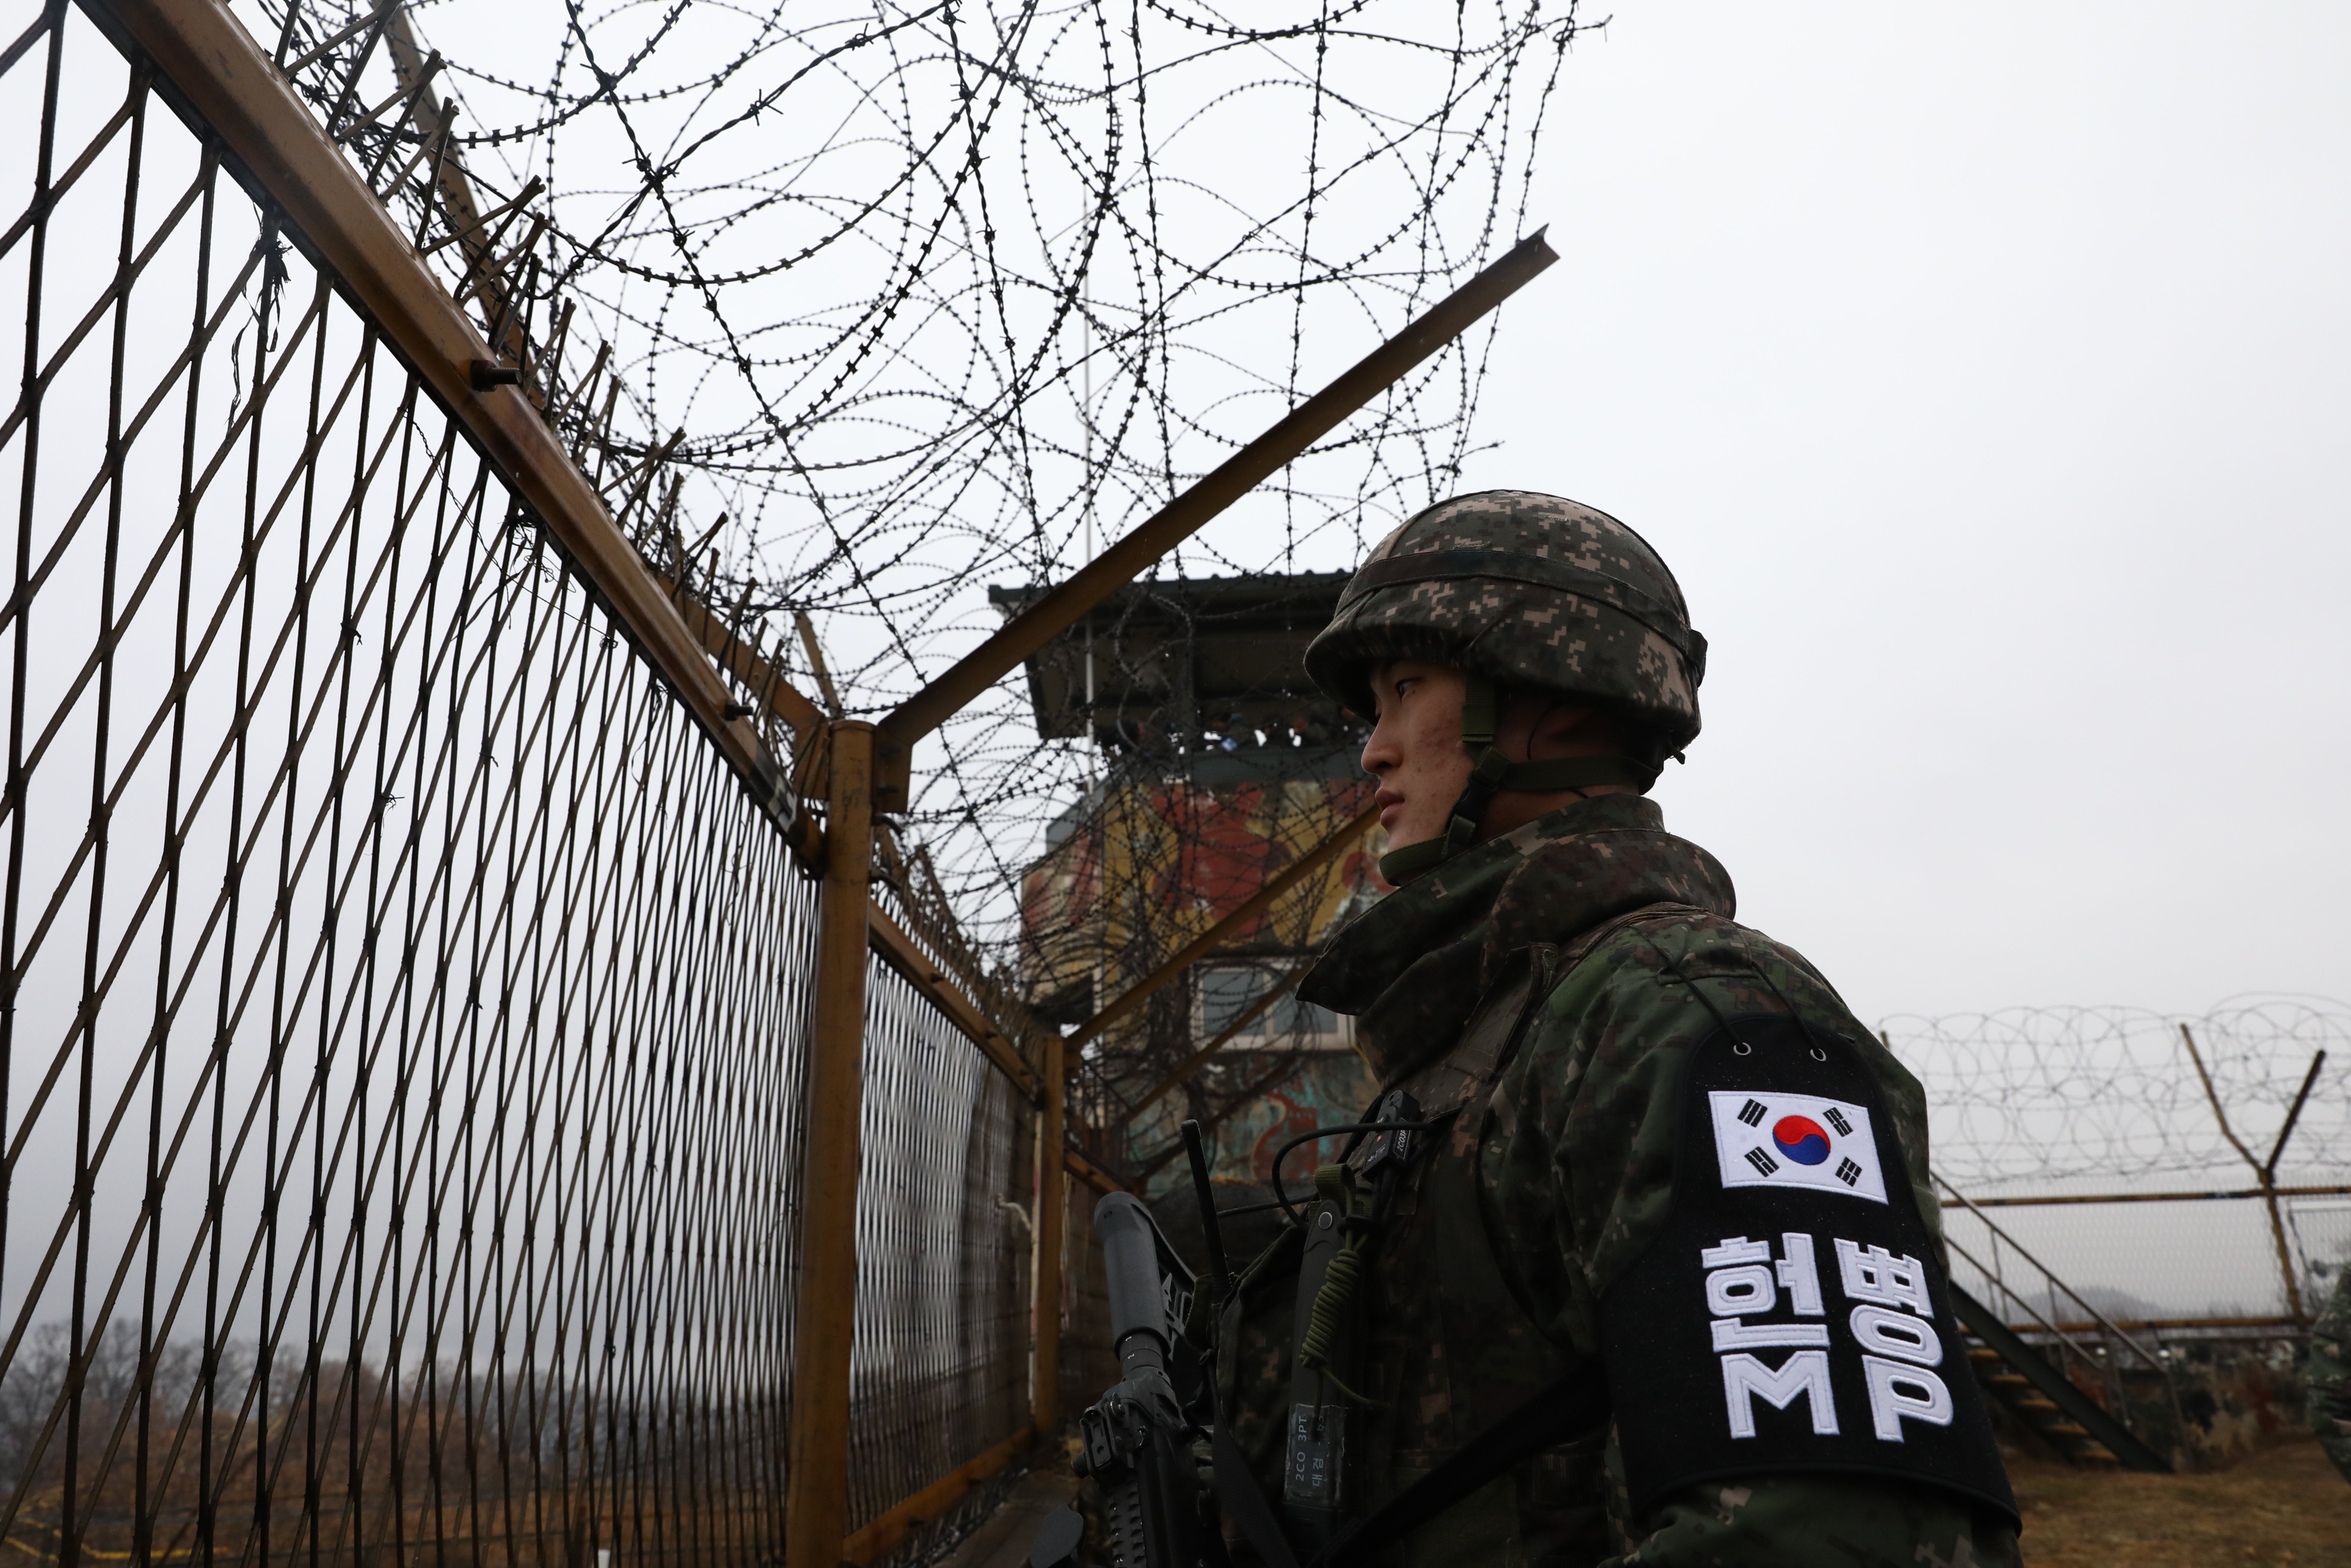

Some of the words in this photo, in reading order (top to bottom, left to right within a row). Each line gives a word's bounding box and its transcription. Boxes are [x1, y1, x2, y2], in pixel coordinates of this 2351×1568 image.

[1397, 1130, 1407, 1152] 2CO3P
[1701, 1232, 1942, 1366] 헌병
[1721, 1350, 1953, 1443] MP
[1298, 1416, 1307, 1442] 3PT
[1296, 1451, 1306, 1482] 2CO
